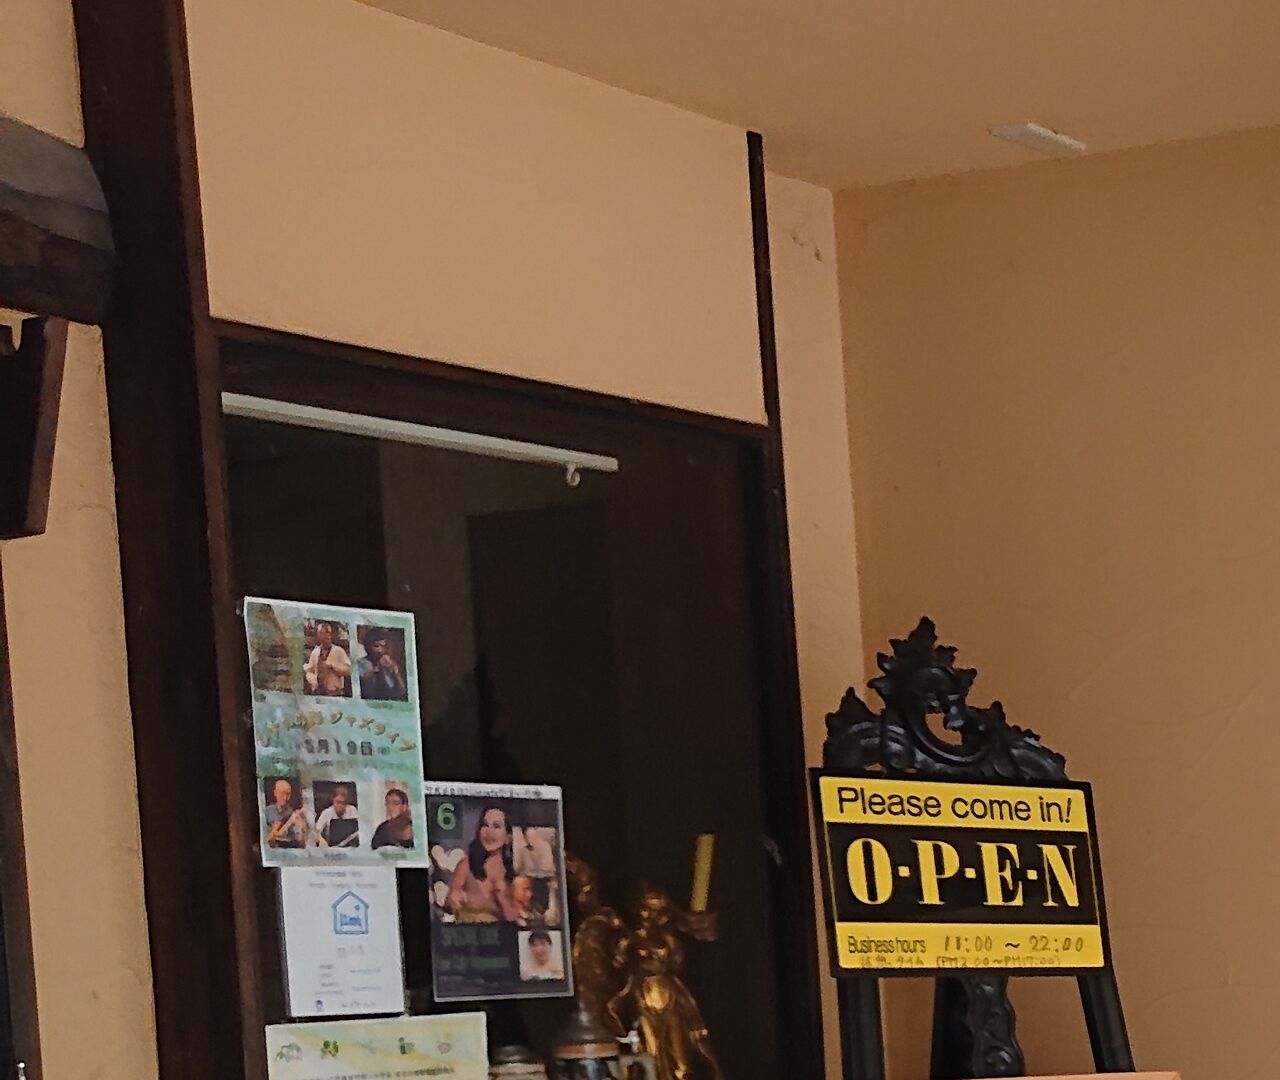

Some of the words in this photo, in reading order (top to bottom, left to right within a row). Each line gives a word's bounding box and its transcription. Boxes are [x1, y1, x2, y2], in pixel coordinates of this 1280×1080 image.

[838, 786, 941, 817] Please
[951, 796, 1031, 821] come
[1039, 796, 1072, 823] in!
[848, 936, 895, 954] Business
[896, 936, 926, 954] hours
[944, 936, 993, 952] 11:00
[1029, 936, 1084, 953] 22:00
